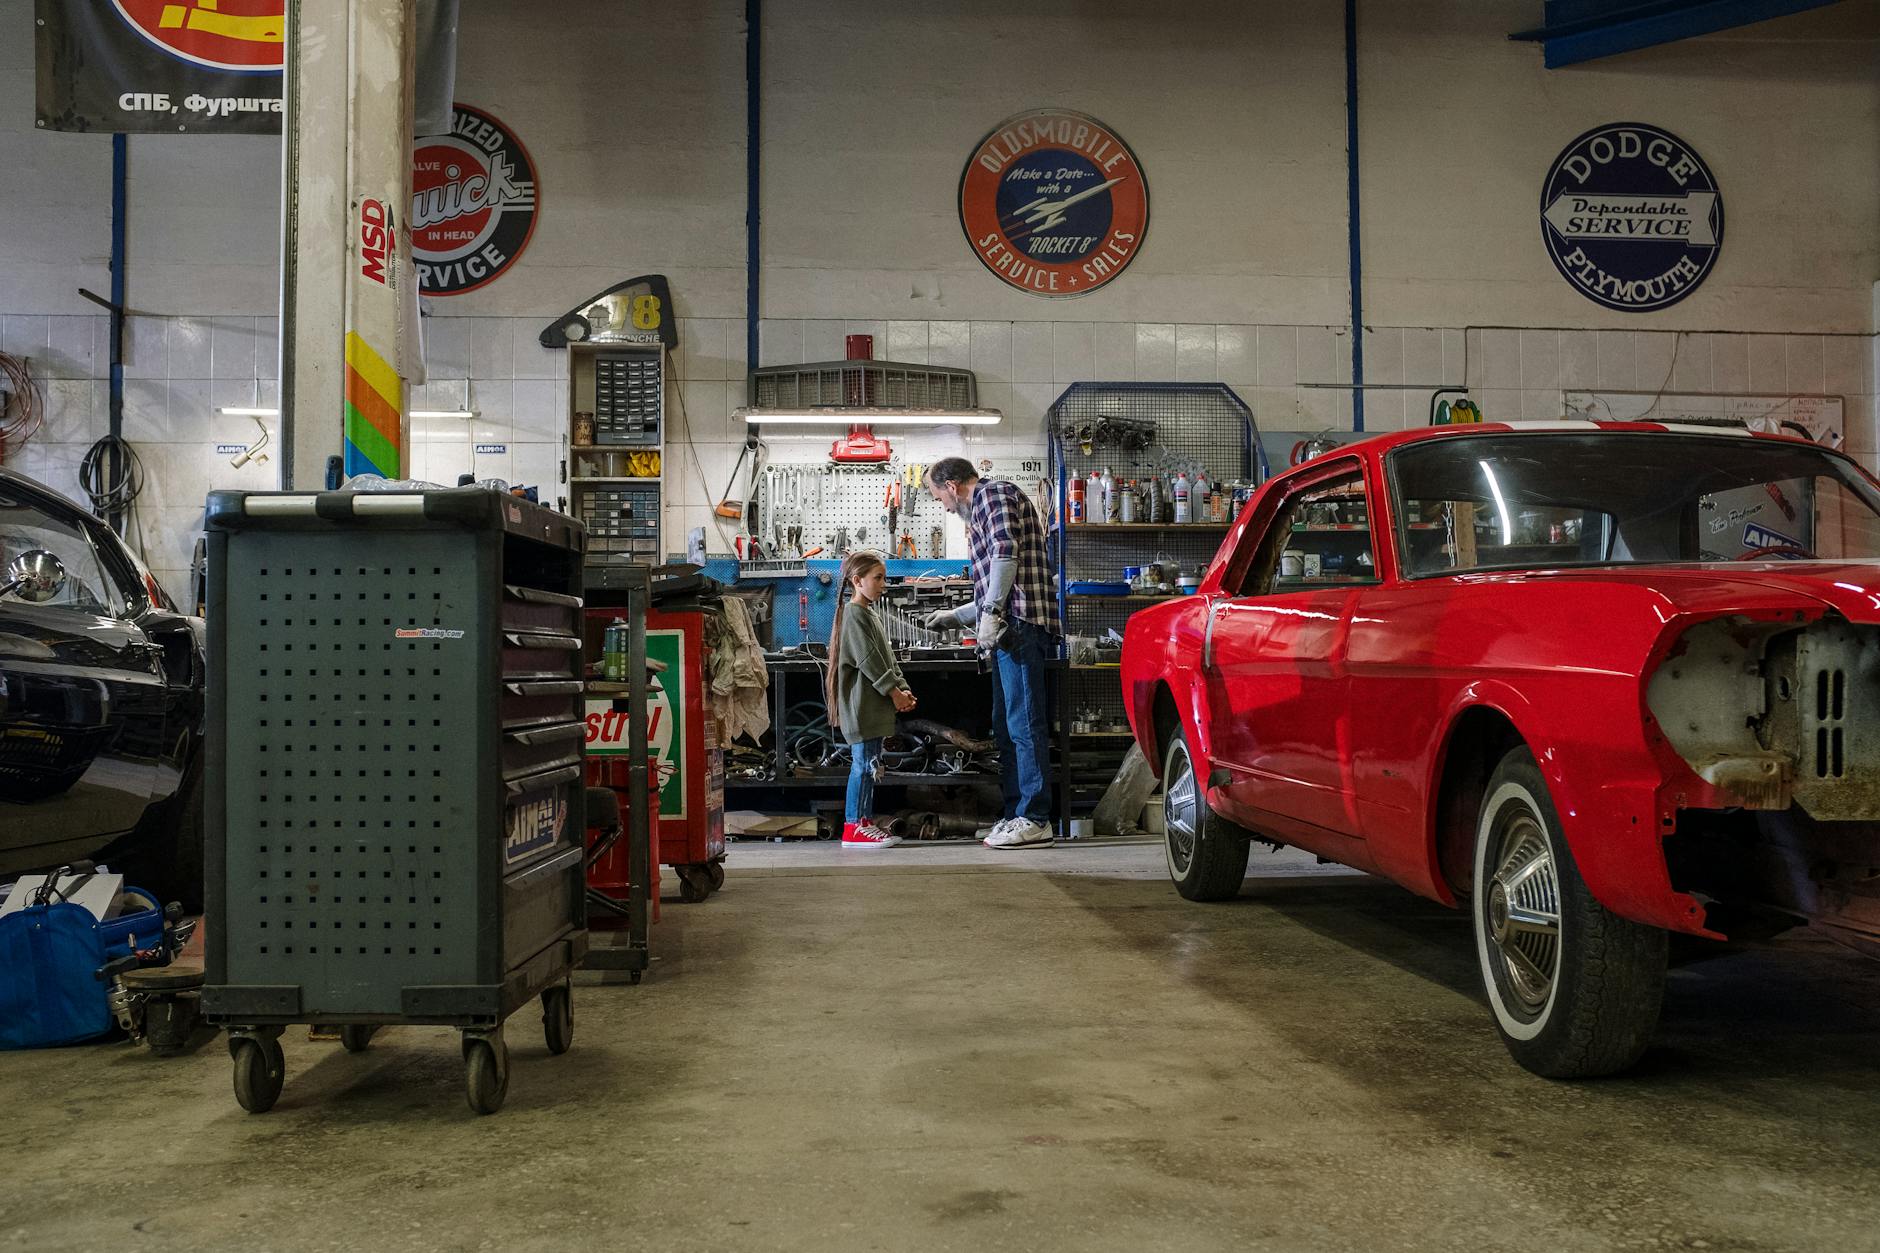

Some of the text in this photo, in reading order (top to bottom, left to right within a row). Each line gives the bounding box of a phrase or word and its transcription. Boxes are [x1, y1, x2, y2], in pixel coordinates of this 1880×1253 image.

[119, 93, 178, 114] СПБ,
[980, 120, 1126, 173] OLDSMOBILE
[1563, 132, 1699, 186] DODGE
[1007, 168, 1040, 182] Make
[1044, 172, 1052, 180] a
[1036, 182, 1071, 194] with a
[1572, 198, 1688, 217] Dependable
[428, 231, 475, 240] IN HEAD
[1566, 217, 1692, 235] SERVICE
[362, 199, 385, 285] MSD
[979, 233, 1059, 290] SERVICE
[1083, 230, 1135, 282] SALES
[1563, 246, 1700, 302] PLYMOUTH
[1021, 461, 1041, 472] 1971
